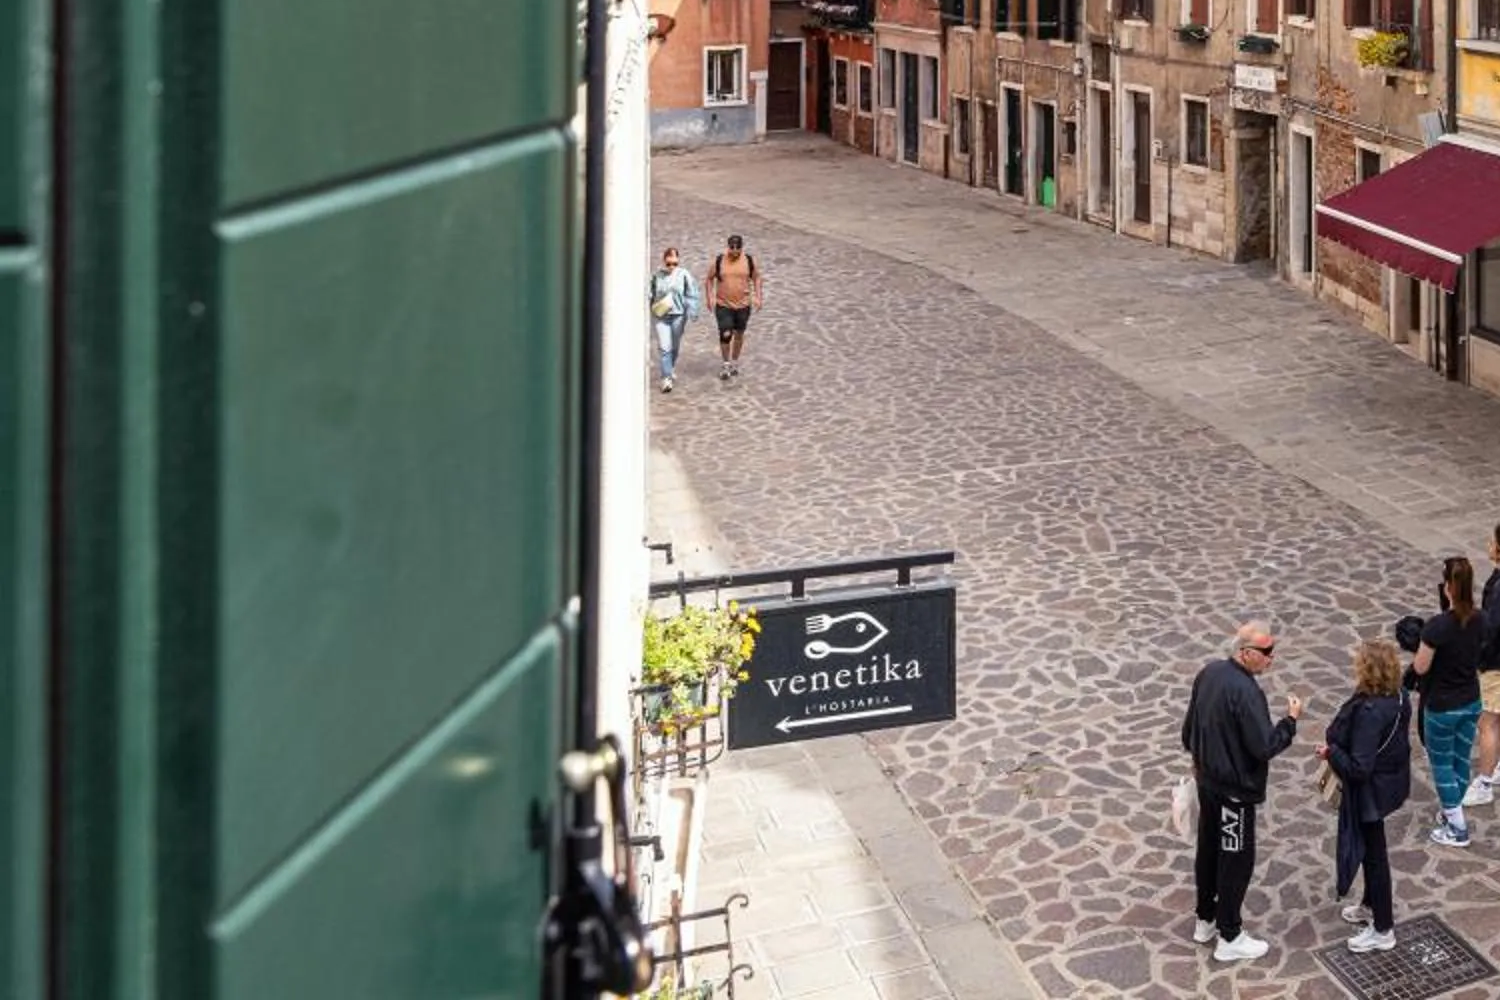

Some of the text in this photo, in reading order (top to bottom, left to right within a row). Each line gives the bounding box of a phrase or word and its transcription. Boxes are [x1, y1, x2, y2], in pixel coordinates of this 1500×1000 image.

[765, 653, 923, 697] venetika
[805, 695, 891, 715] L'HOSTARIA
[1221, 805, 1239, 851] EA7
